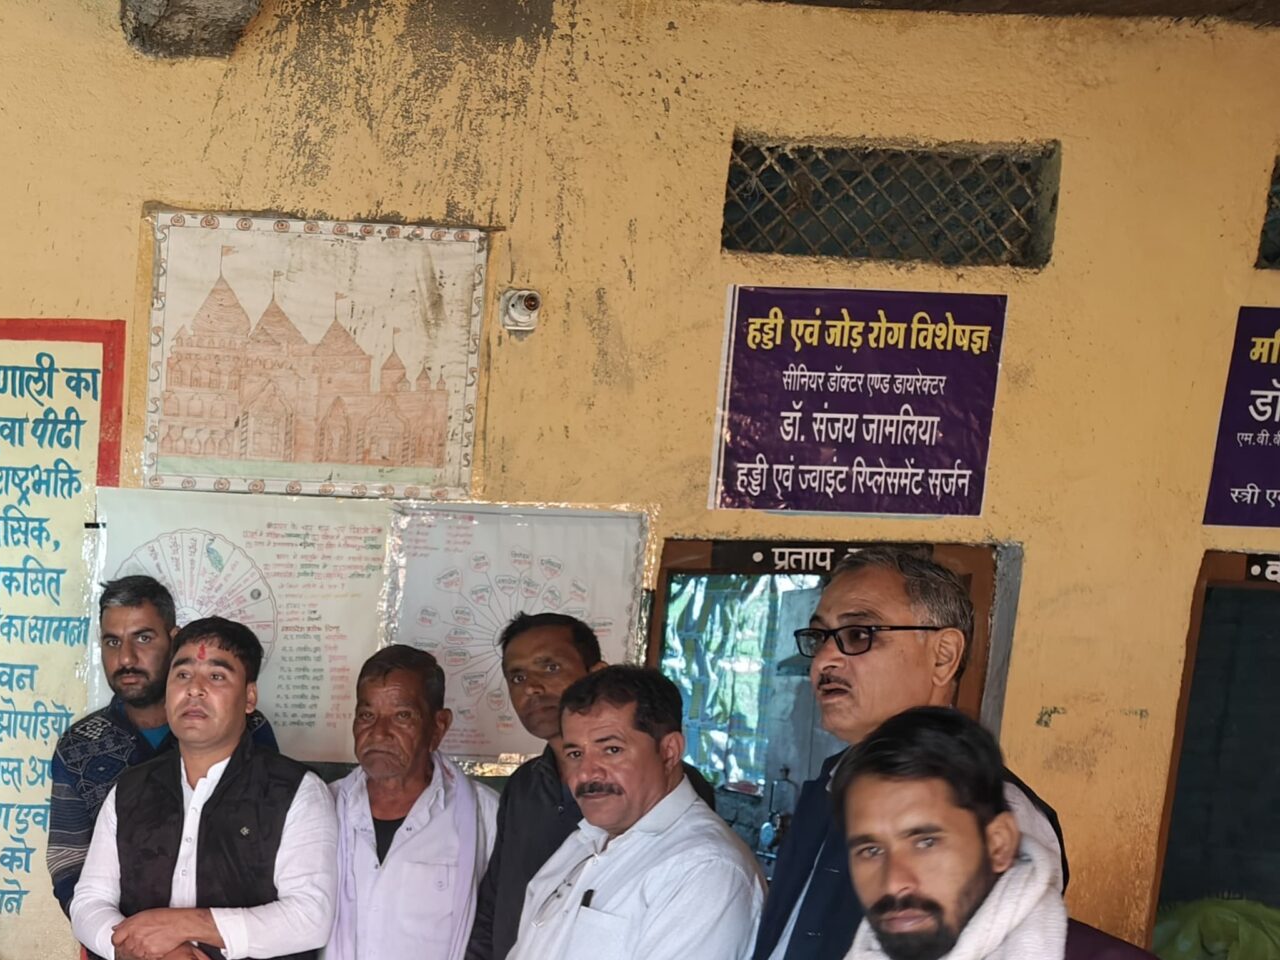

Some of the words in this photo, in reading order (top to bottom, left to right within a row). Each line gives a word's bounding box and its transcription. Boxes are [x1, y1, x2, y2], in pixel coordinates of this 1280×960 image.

[747, 307, 784, 350] हड्डी
[790, 309, 821, 352] एवं
[825, 308, 864, 353] जोड़
[868, 309, 907, 350] रोग
[910, 311, 992, 355] विशेषज्ञ
[61, 367, 101, 401] का
[782, 363, 826, 392] सीनियर
[827, 365, 864, 393] डॉक्टर
[867, 373, 890, 397] एण्ड
[892, 368, 947, 395] डायरेक्टर
[1248, 378, 1280, 421] डॉ
[779, 400, 806, 442] डॉ.
[811, 402, 859, 443] संजय
[862, 404, 940, 446] जामलिया
[736, 453, 769, 496] हड्डी
[773, 455, 795, 499] एवं
[798, 456, 848, 498] ज्वाइंट
[851, 456, 925, 496] रिप्लेसमेंट
[927, 459, 972, 499] सर्जन
[1230, 483, 1261, 504] स्त्री
[771, 548, 834, 571] प्रताप
[0, 614, 29, 643] का
[28, 614, 91, 647] सामना
[0, 835, 36, 873] को
